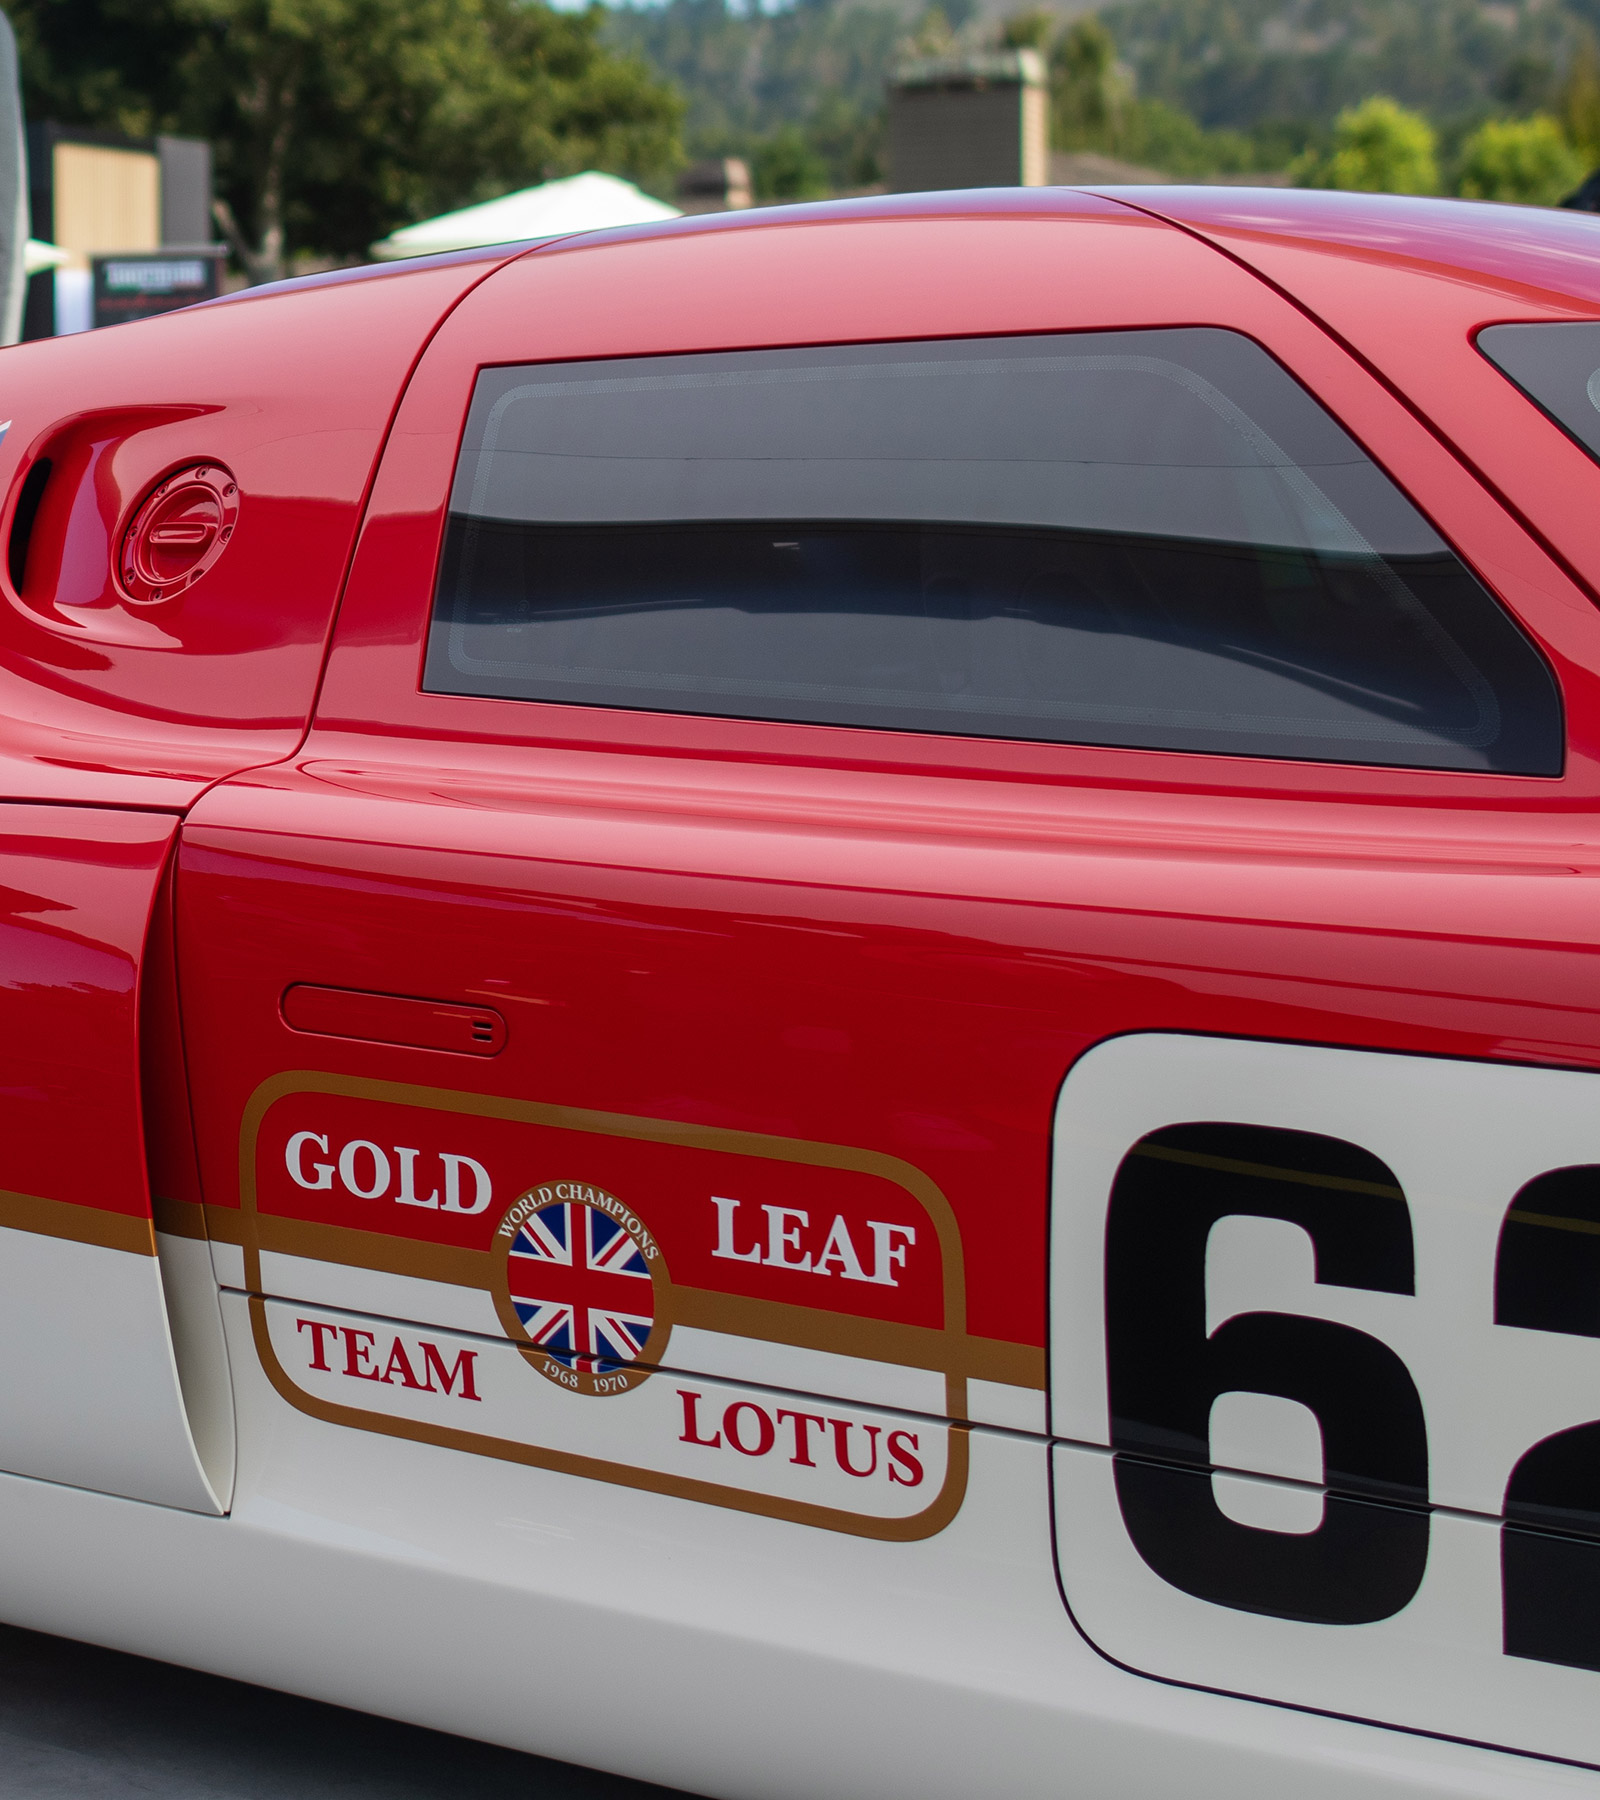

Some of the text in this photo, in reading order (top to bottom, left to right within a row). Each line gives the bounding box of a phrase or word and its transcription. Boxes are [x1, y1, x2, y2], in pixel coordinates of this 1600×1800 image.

[285, 1130, 916, 1287] GOLD LEAF
[498, 1183, 659, 1261] WORLD CHAMPIONS
[296, 1318, 925, 1487] TEAM LOTUS
[542, 1360, 629, 1393] 1968 1970
